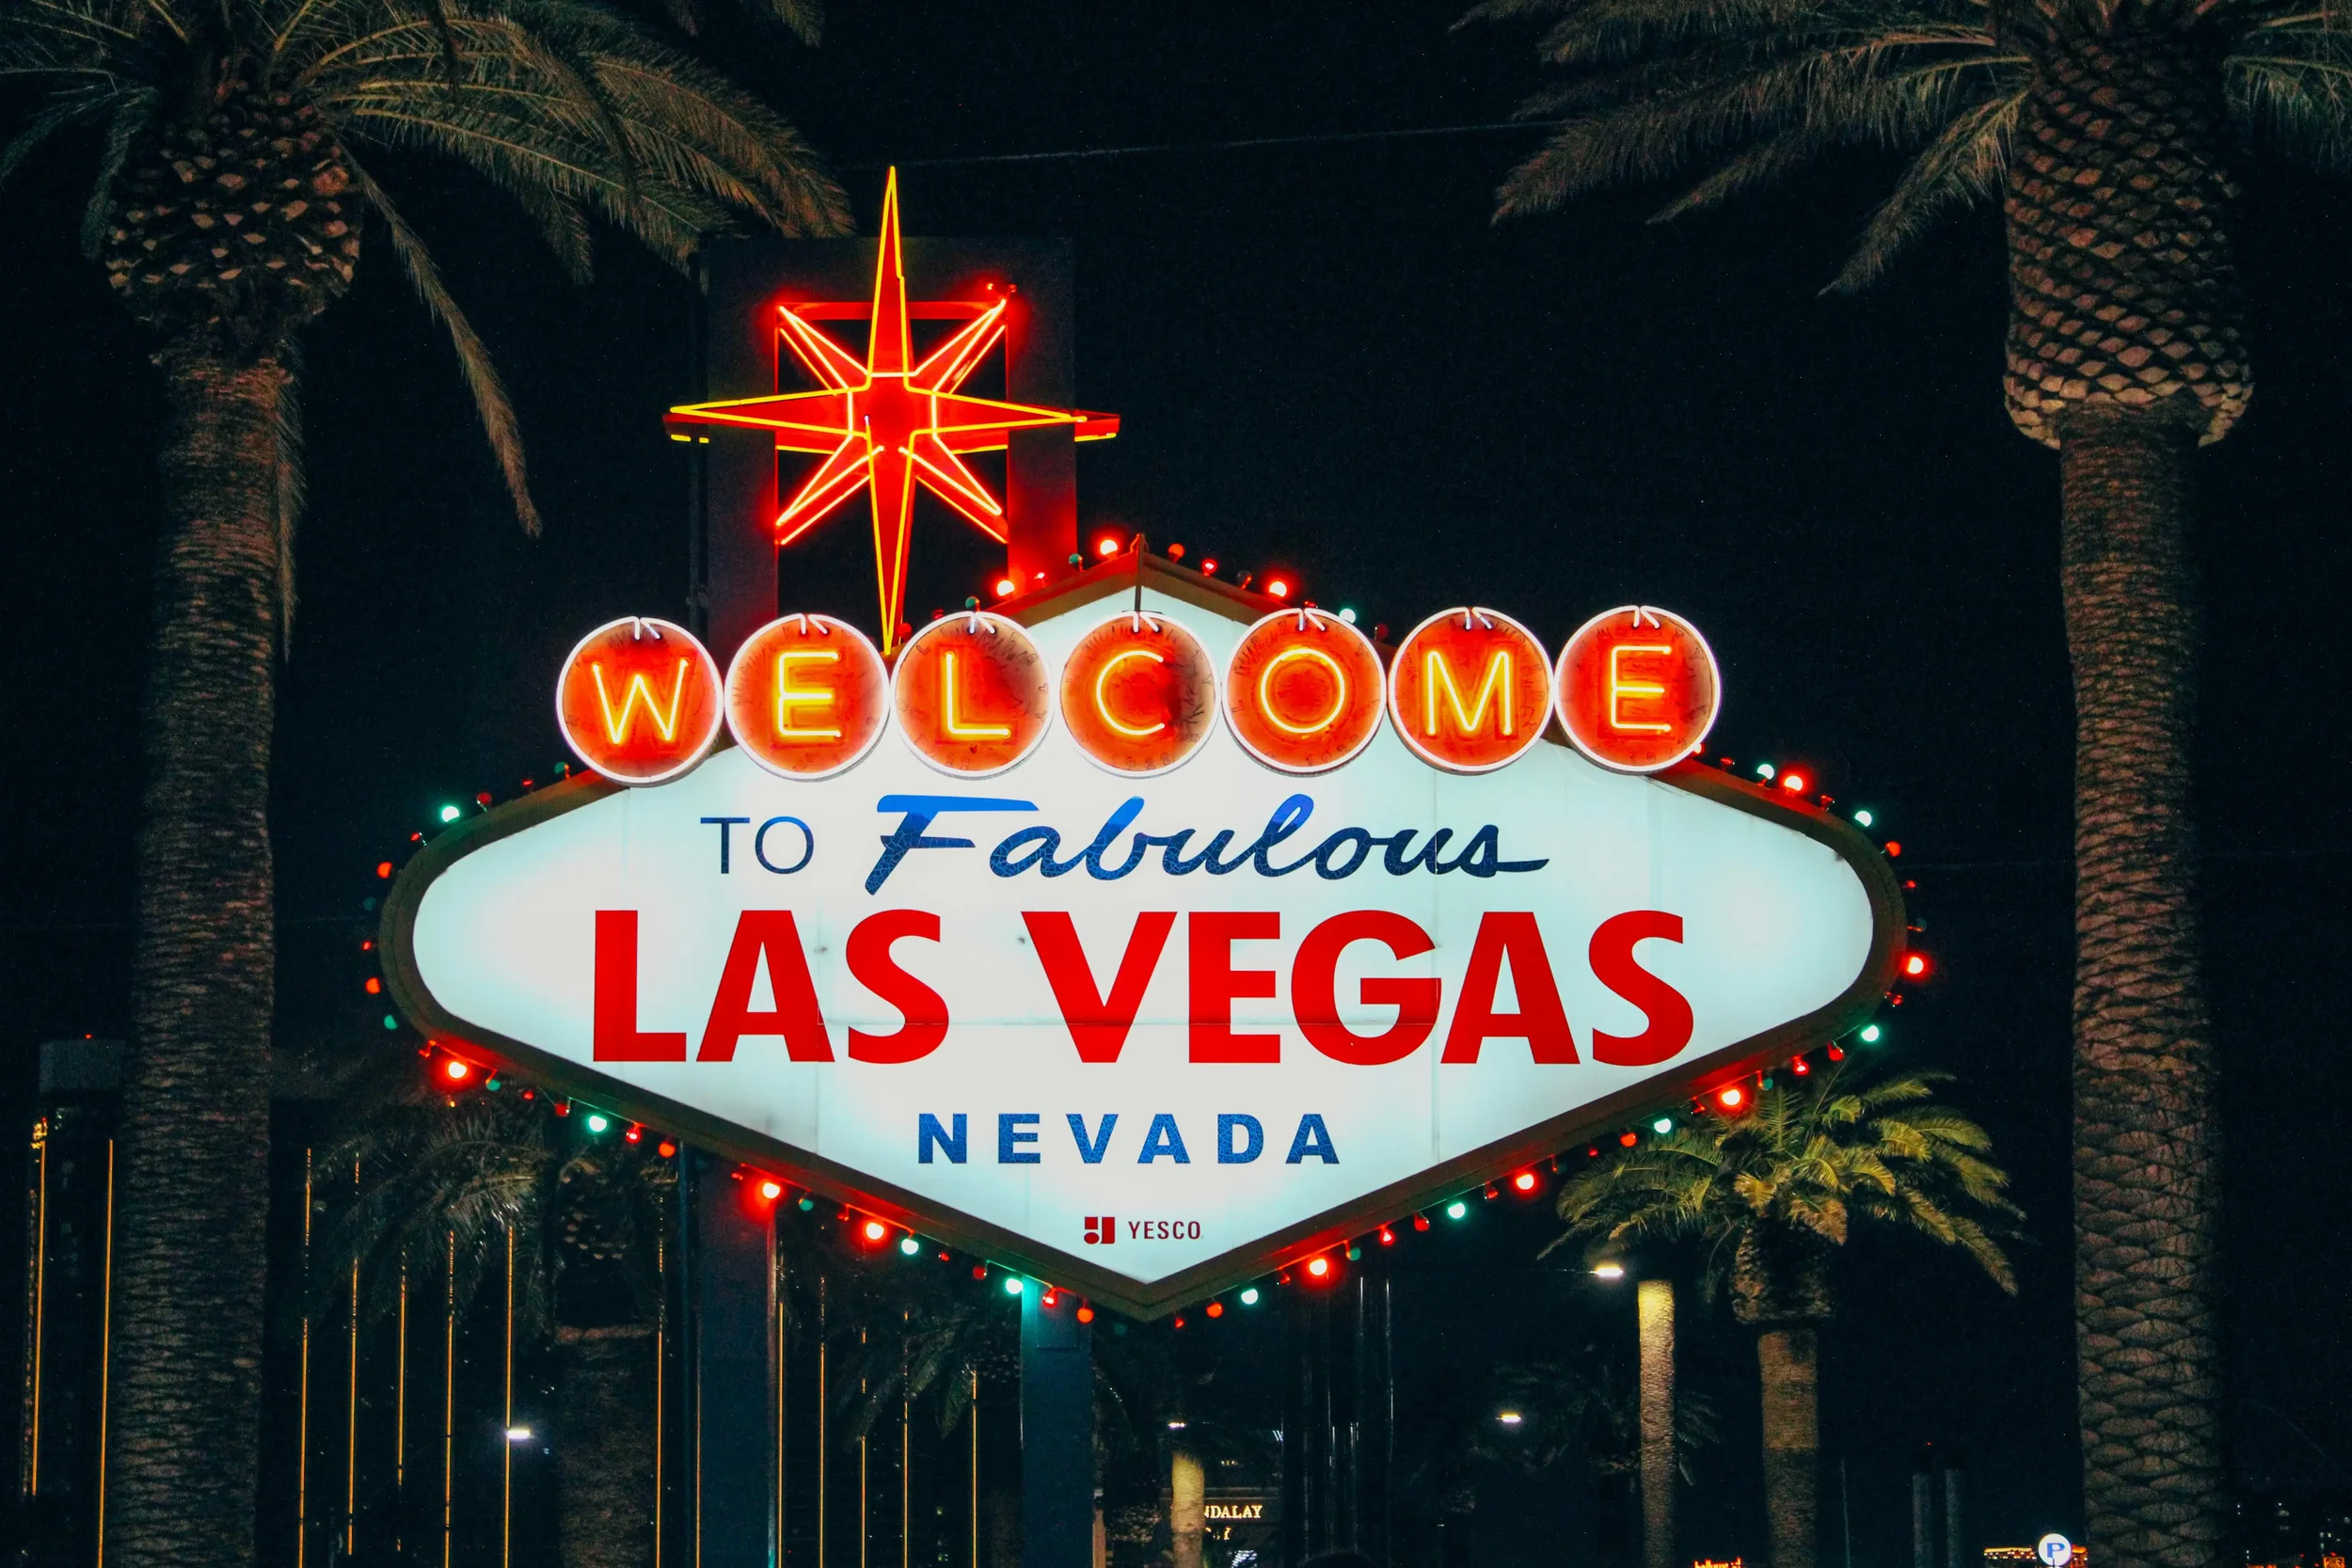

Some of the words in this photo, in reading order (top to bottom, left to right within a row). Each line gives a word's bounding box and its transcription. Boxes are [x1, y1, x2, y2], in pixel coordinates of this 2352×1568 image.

[591, 643, 1675, 748] WELCOME
[699, 816, 815, 875] TO
[865, 793, 1550, 896] Fabulous
[593, 909, 949, 1065] LAS
[1021, 910, 1694, 1067] VEGAS
[917, 1113, 1341, 1164] NEVADA
[1127, 1220, 1201, 1240] YESCO
[2046, 1542, 2066, 1559] P
